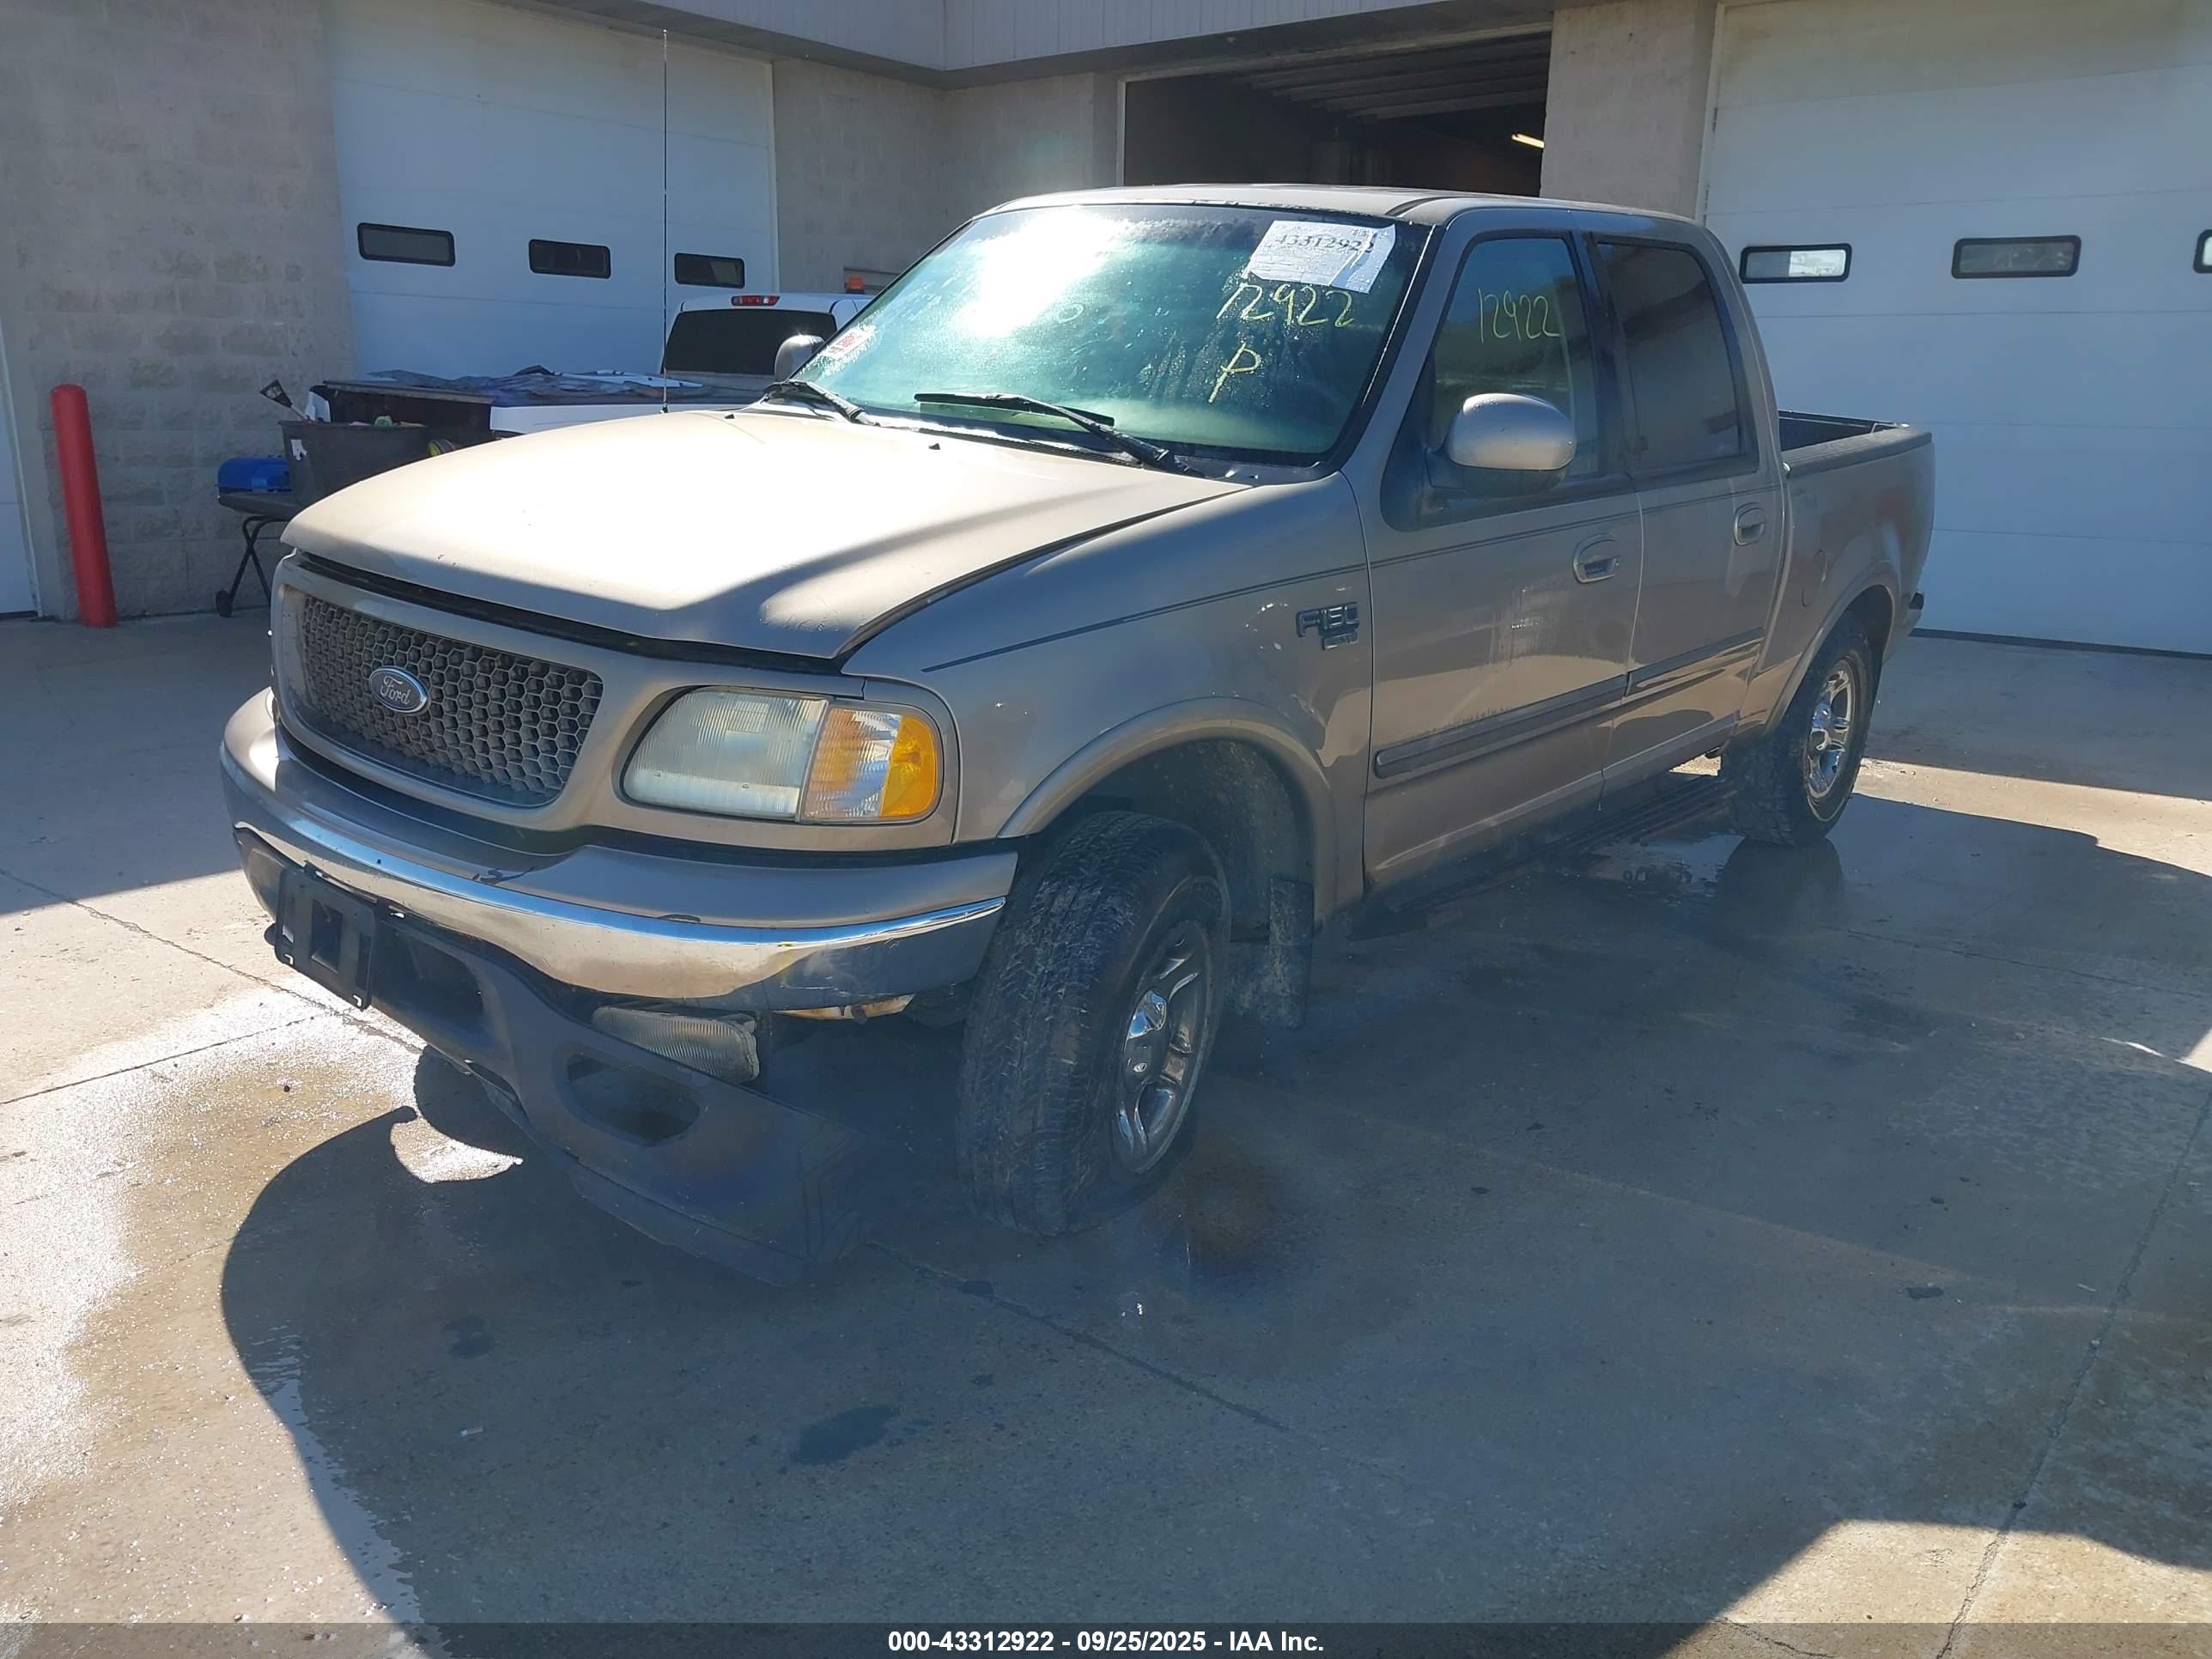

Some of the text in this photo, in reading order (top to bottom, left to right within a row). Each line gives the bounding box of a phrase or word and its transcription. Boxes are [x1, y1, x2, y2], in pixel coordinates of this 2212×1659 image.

[1216, 282, 1355, 328] 12922
[1477, 288, 1561, 343] 12922
[380, 675, 411, 705] Ford
